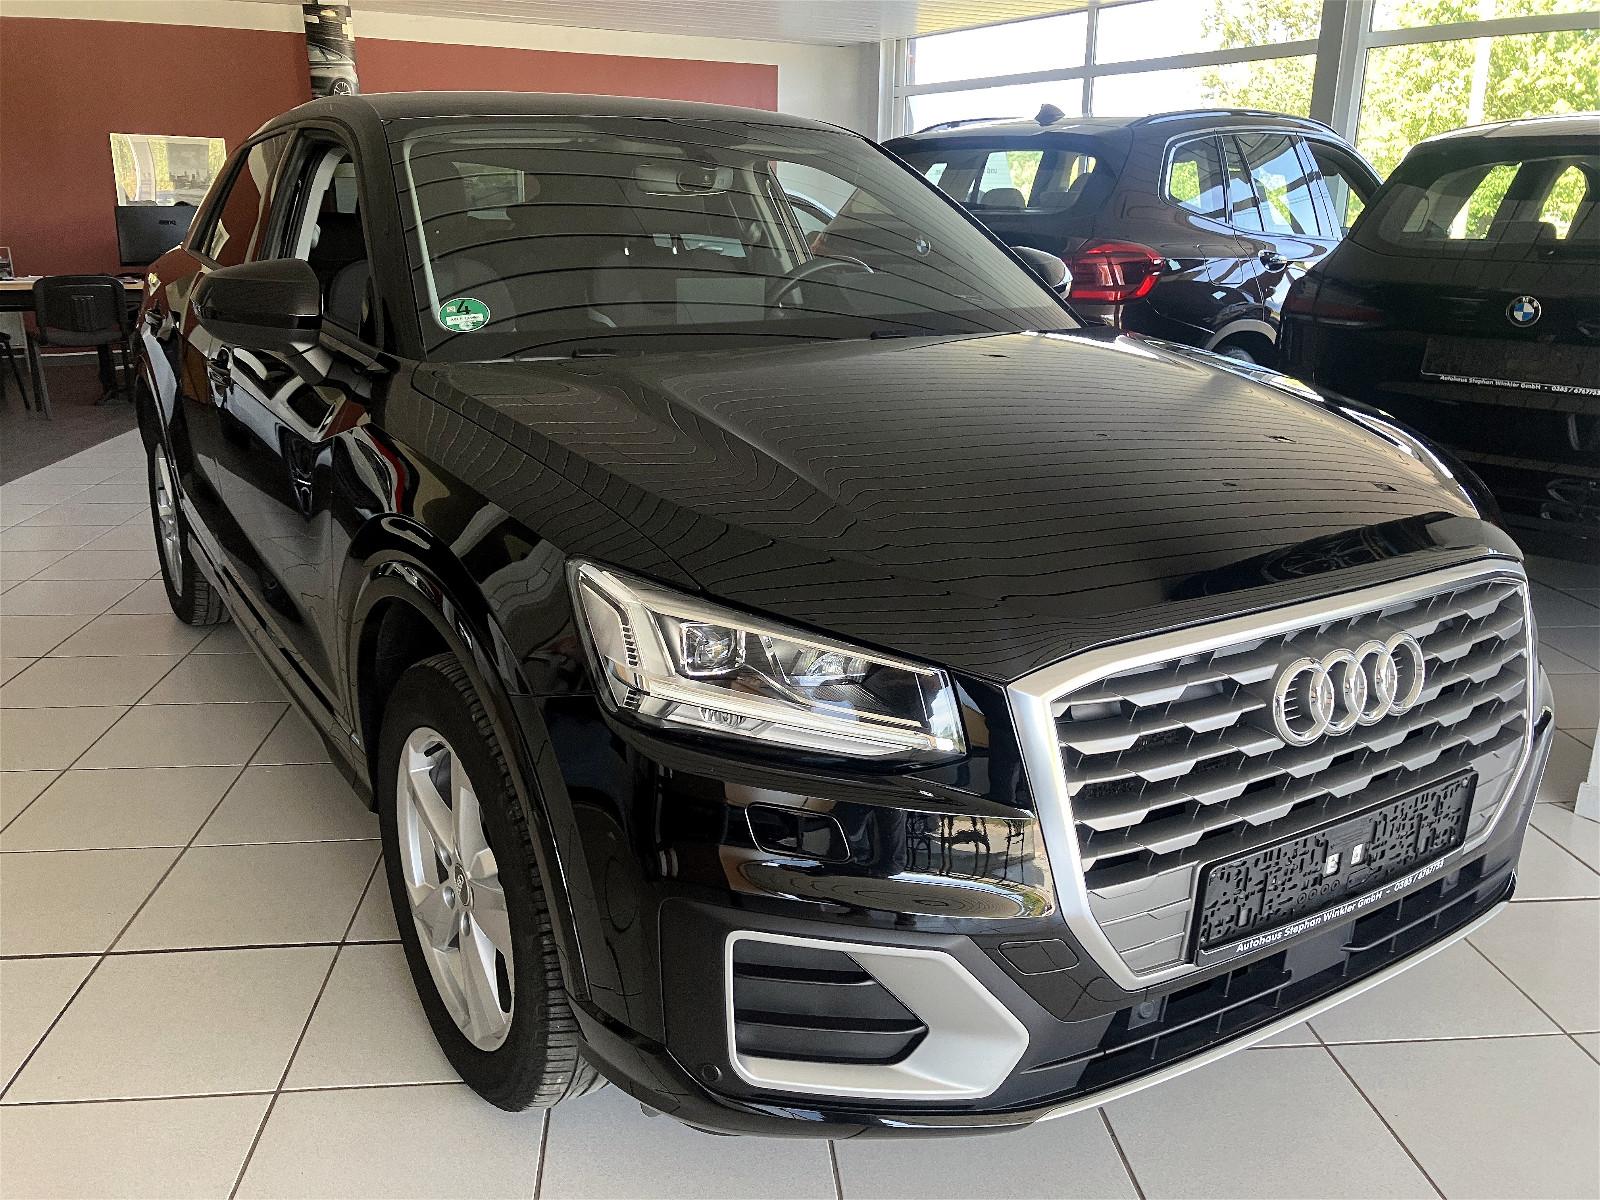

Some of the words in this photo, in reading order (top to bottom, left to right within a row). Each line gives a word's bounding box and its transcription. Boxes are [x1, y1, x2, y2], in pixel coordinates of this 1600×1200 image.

[457, 300, 471, 314] 4
[1440, 375, 1467, 383] Autohaus
[1469, 377, 1493, 385] Stephan
[1495, 380, 1520, 388] Winkler
[1236, 931, 1283, 953] Autohaus
[1284, 917, 1322, 937] Stephan
[1323, 904, 1356, 922] Winkler
[1357, 891, 1383, 908] GmbH
